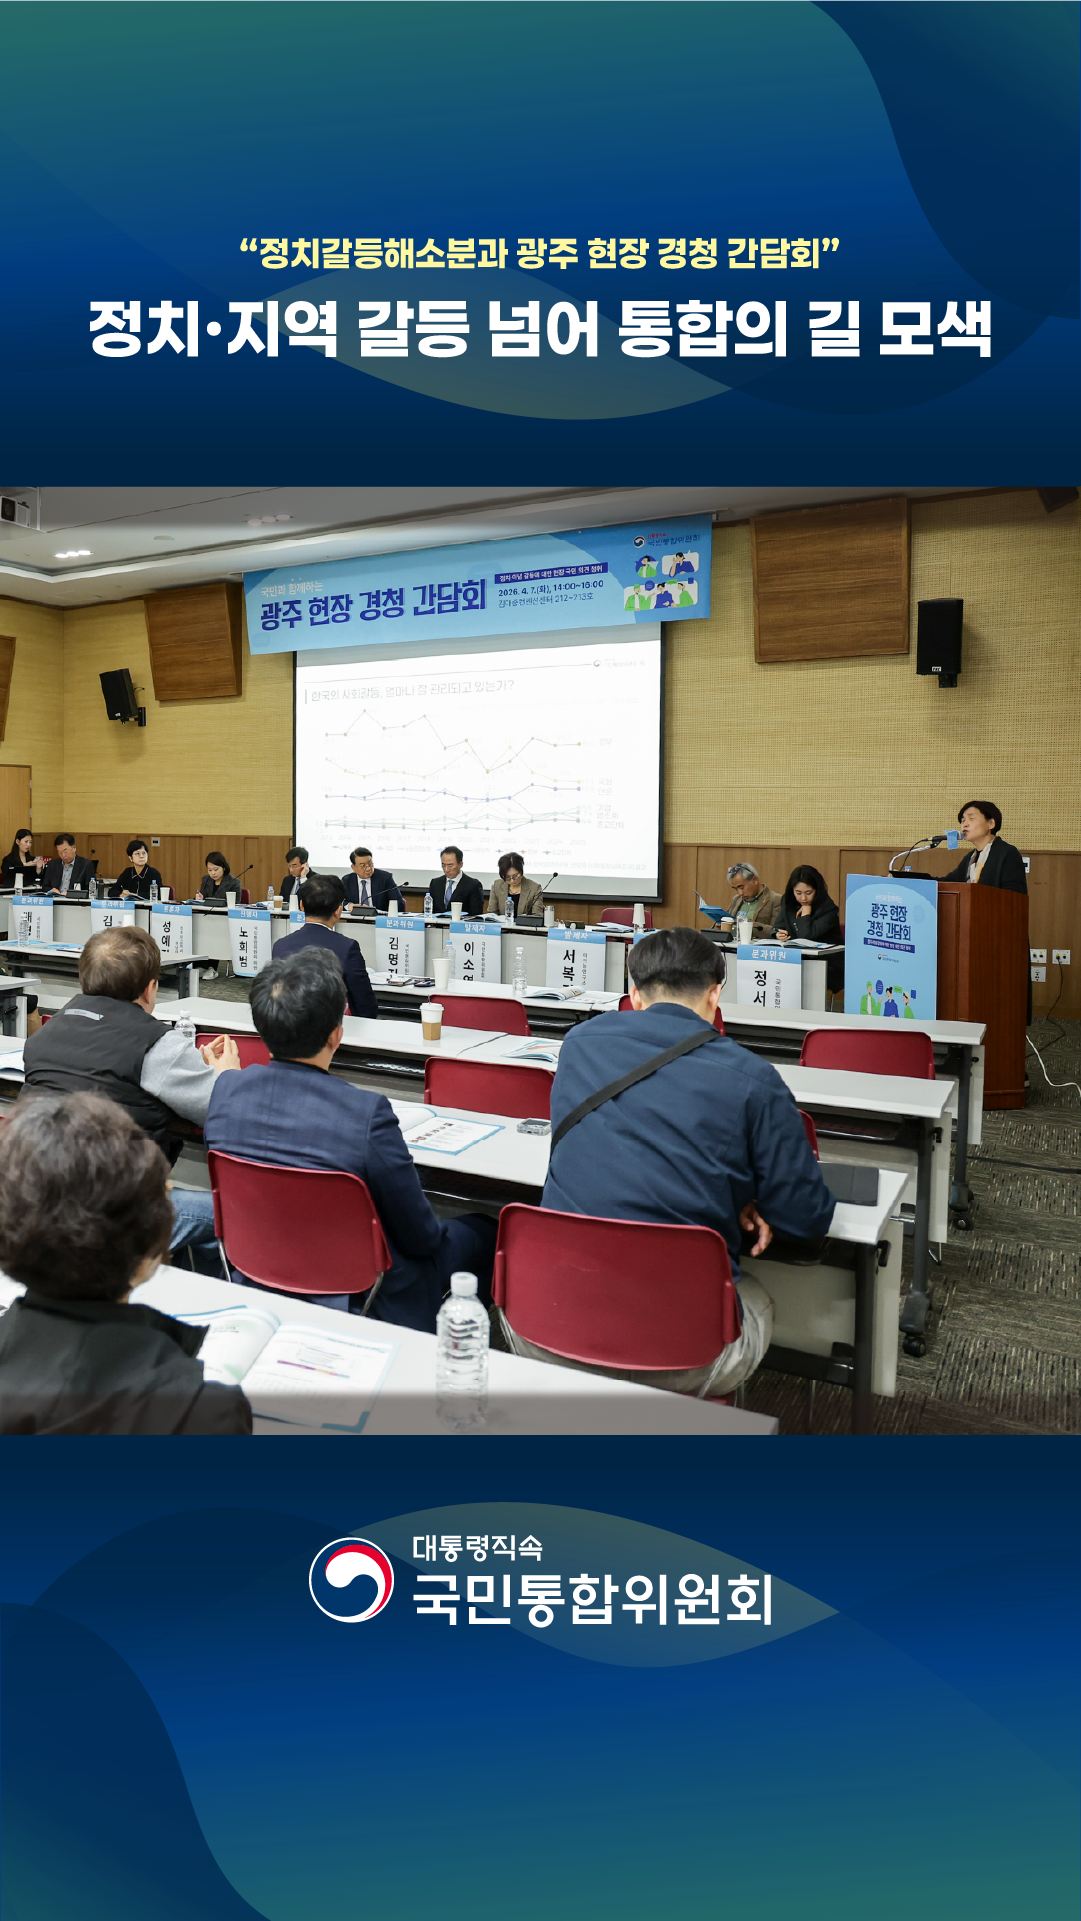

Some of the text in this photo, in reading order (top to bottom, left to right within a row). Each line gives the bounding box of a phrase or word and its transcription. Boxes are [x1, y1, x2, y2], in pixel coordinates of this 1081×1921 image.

[261, 581, 324, 598] 국민과 함께하는
[499, 588, 520, 597] 2026.
[260, 579, 488, 631] 광주 현장 경청 간담회
[311, 679, 515, 702] 한국의 사회갈등, 얼마나 잘 관리되고 있는가?
[871, 903, 907, 923] 광주 현장
[386, 919, 414, 928] 분과위원
[465, 924, 486, 933] 발제자
[867, 920, 911, 941] 경청 간담회
[162, 921, 171, 953] 성예
[565, 931, 588, 940] 발제자
[239, 927, 248, 967] 노회범
[752, 949, 786, 960] 분과위원
[563, 949, 575, 987] 서복
